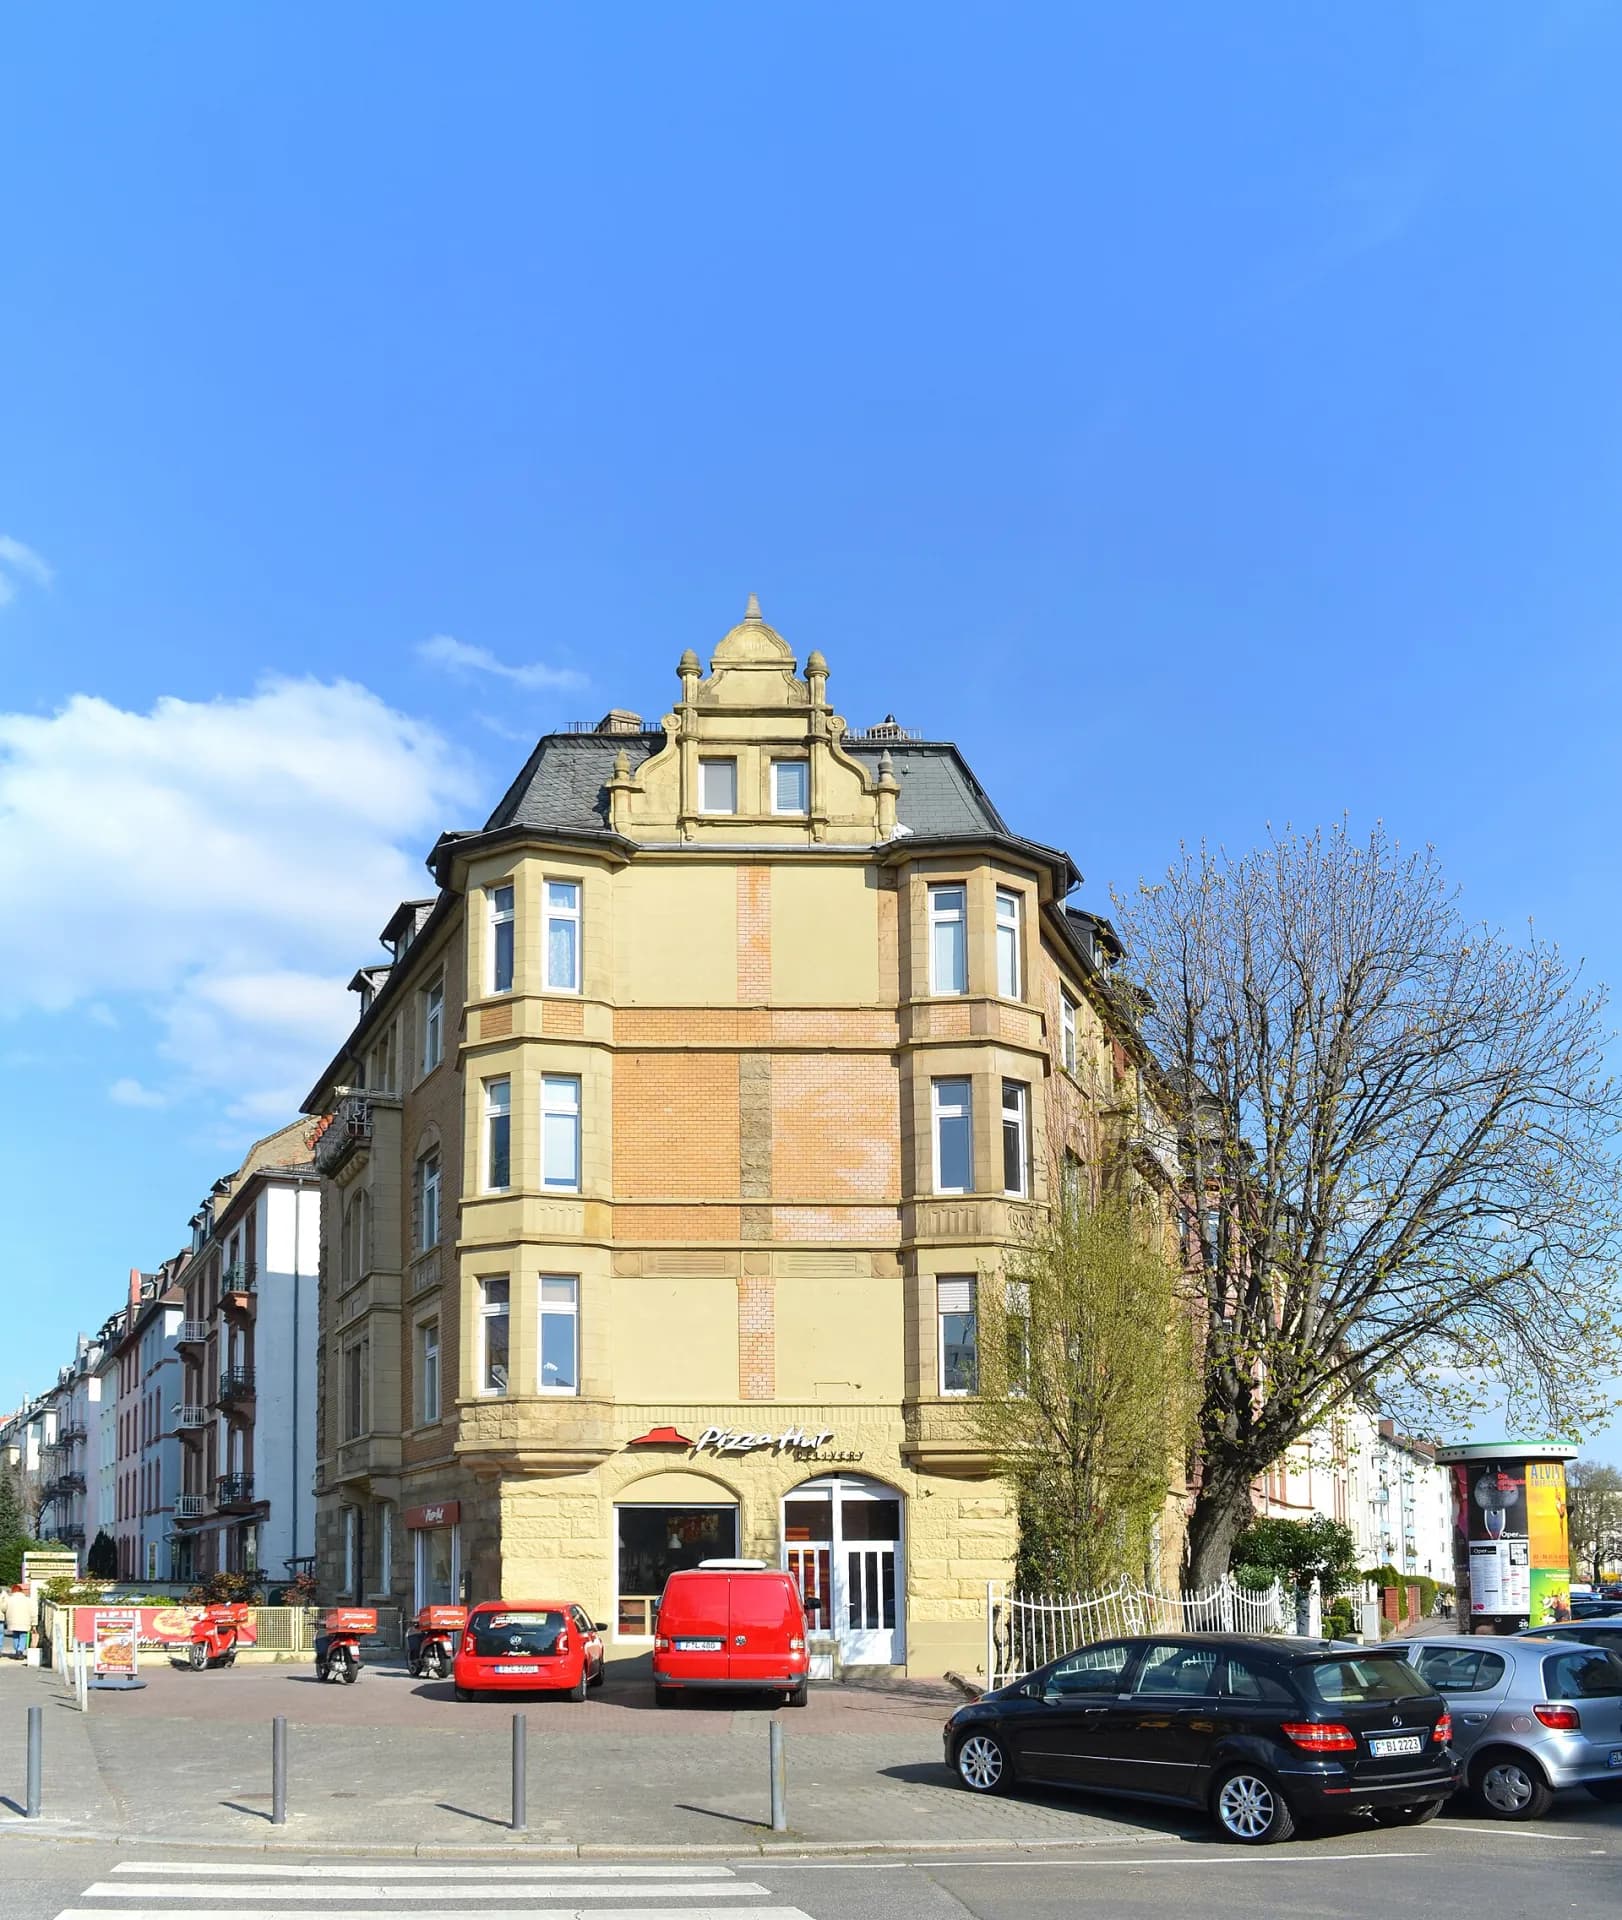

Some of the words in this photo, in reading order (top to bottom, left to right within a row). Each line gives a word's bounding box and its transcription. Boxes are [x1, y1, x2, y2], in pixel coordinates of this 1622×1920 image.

[695, 1426, 774, 1450] Pizza
[778, 1427, 834, 1449] Hut
[797, 1450, 864, 1461] DELIVERY
[1398, 1738, 1419, 1751] 2223
